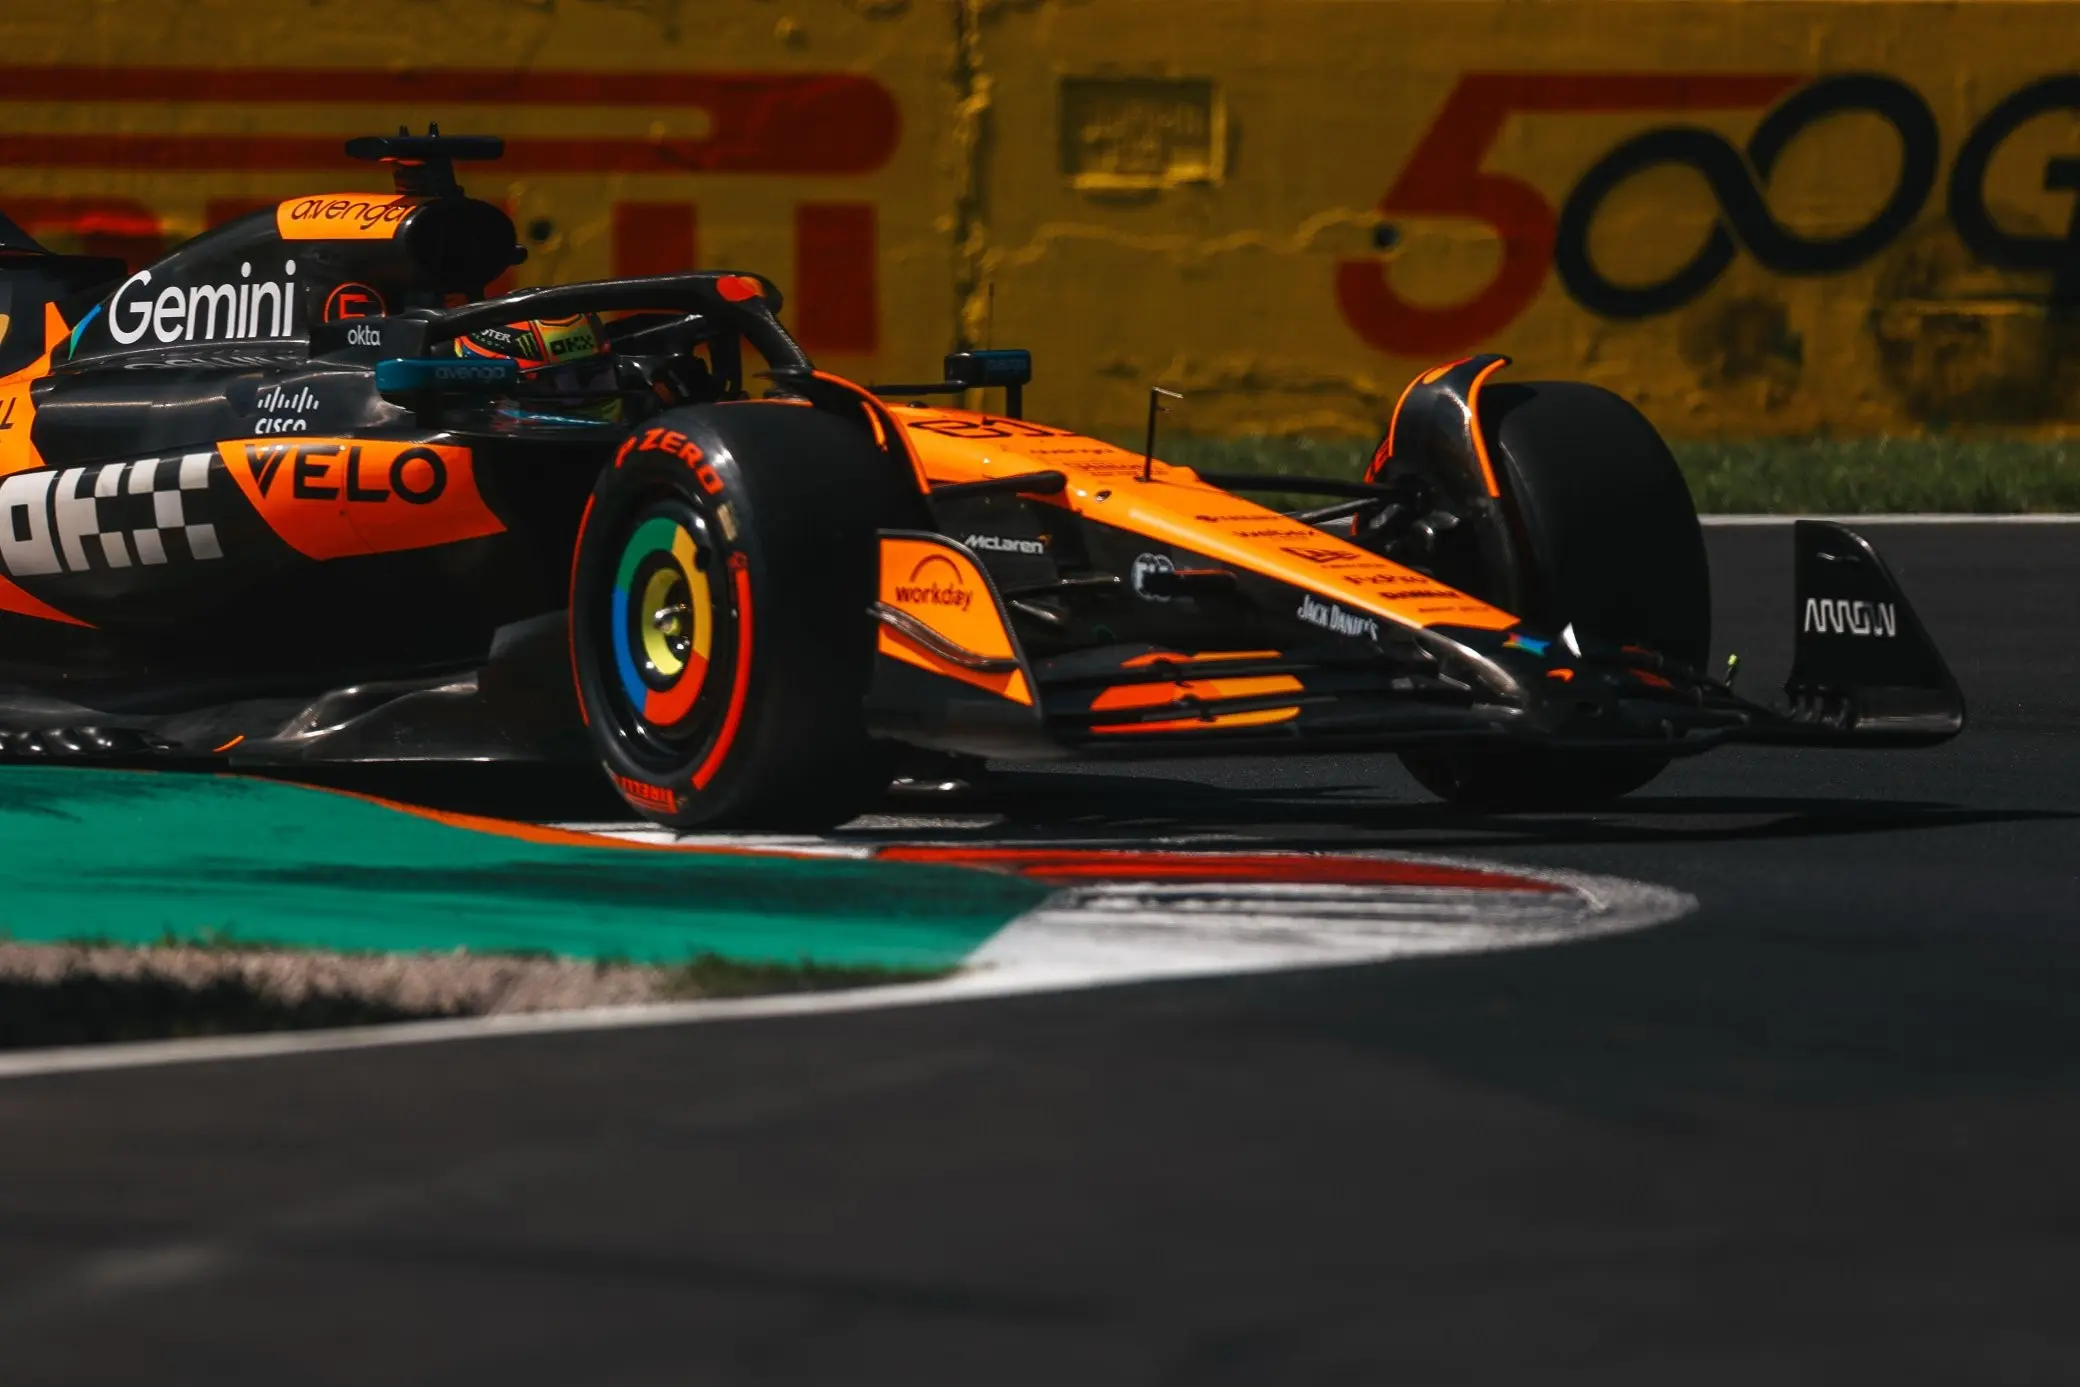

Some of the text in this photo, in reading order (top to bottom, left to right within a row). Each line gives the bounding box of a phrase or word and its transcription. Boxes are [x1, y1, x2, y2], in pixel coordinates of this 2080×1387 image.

[291, 199, 416, 230] avenga
[108, 260, 296, 344] Gemini
[347, 325, 381, 346] okta
[435, 366, 506, 383] avenga
[242, 444, 448, 504] VELO
[637, 427, 725, 496] ZERO
[963, 533, 1043, 556] McLaren
[894, 582, 974, 613] workday
